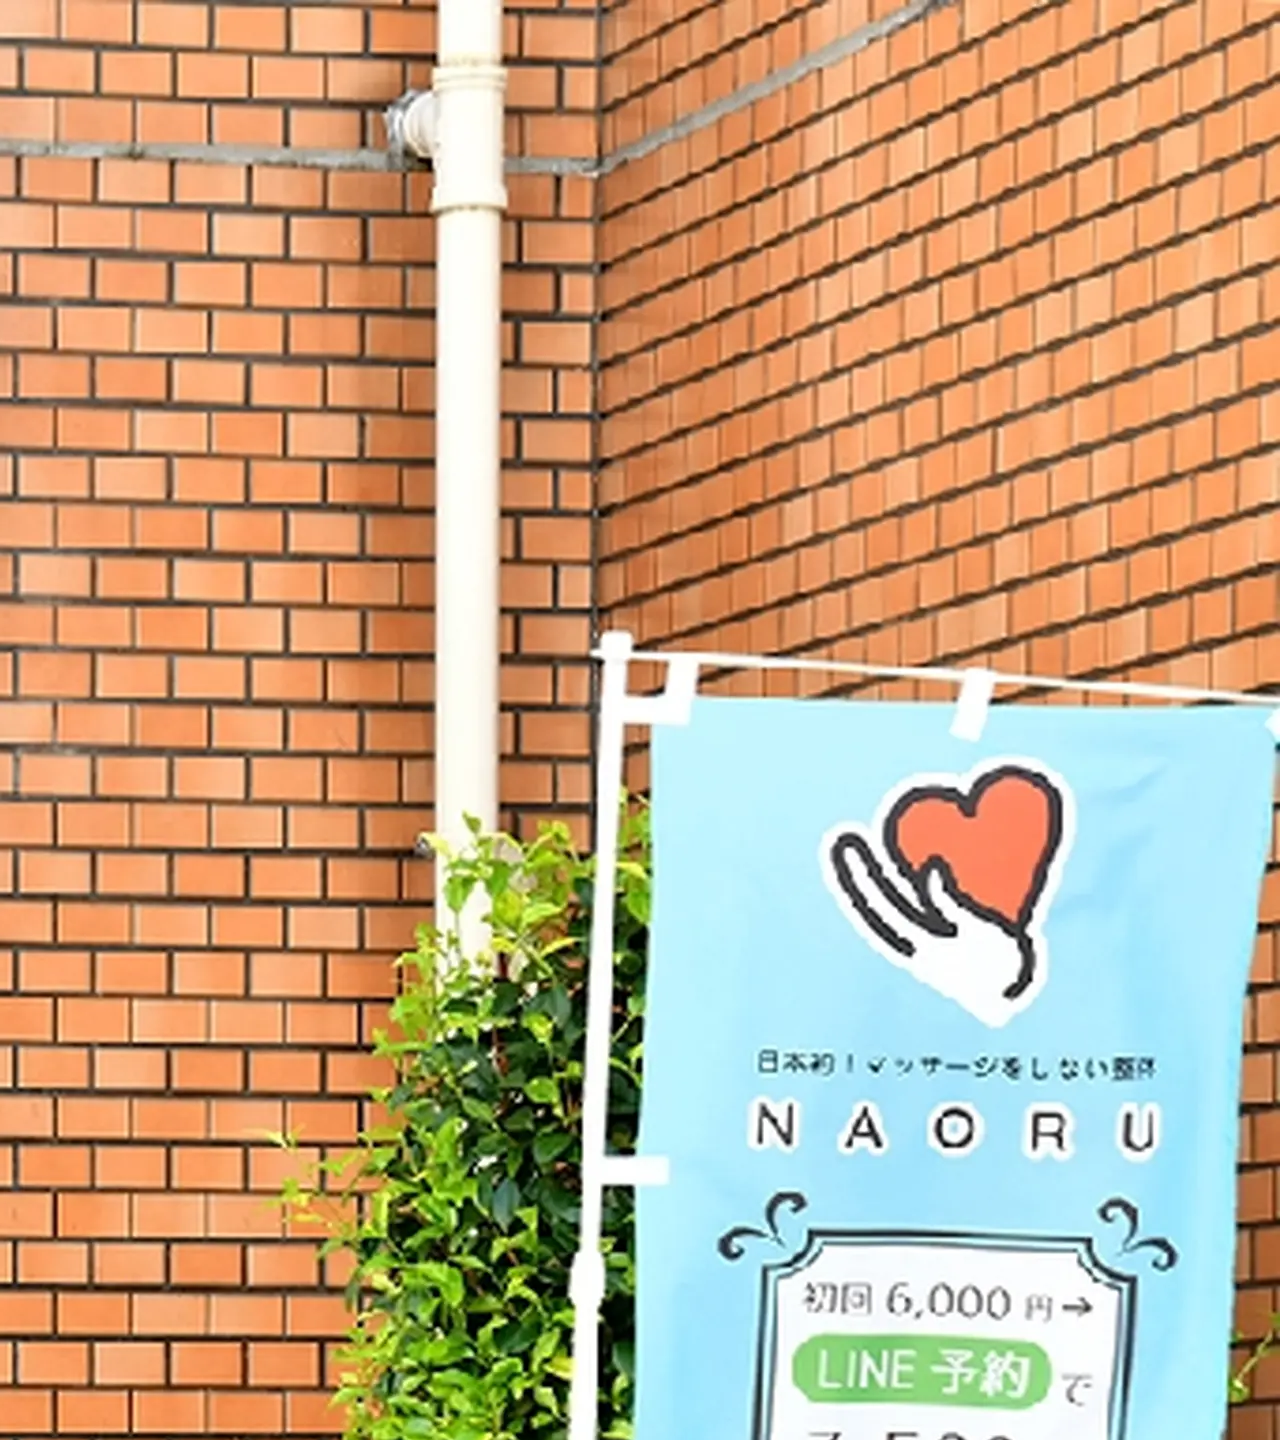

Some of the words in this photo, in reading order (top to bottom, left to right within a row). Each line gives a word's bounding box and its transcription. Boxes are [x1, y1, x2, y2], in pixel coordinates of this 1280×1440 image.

[757, 1103, 1154, 1151] NAORU
[803, 1282, 872, 1315] 初回
[817, 1349, 915, 1390] LINE
[931, 1352, 1031, 1398] 予約
